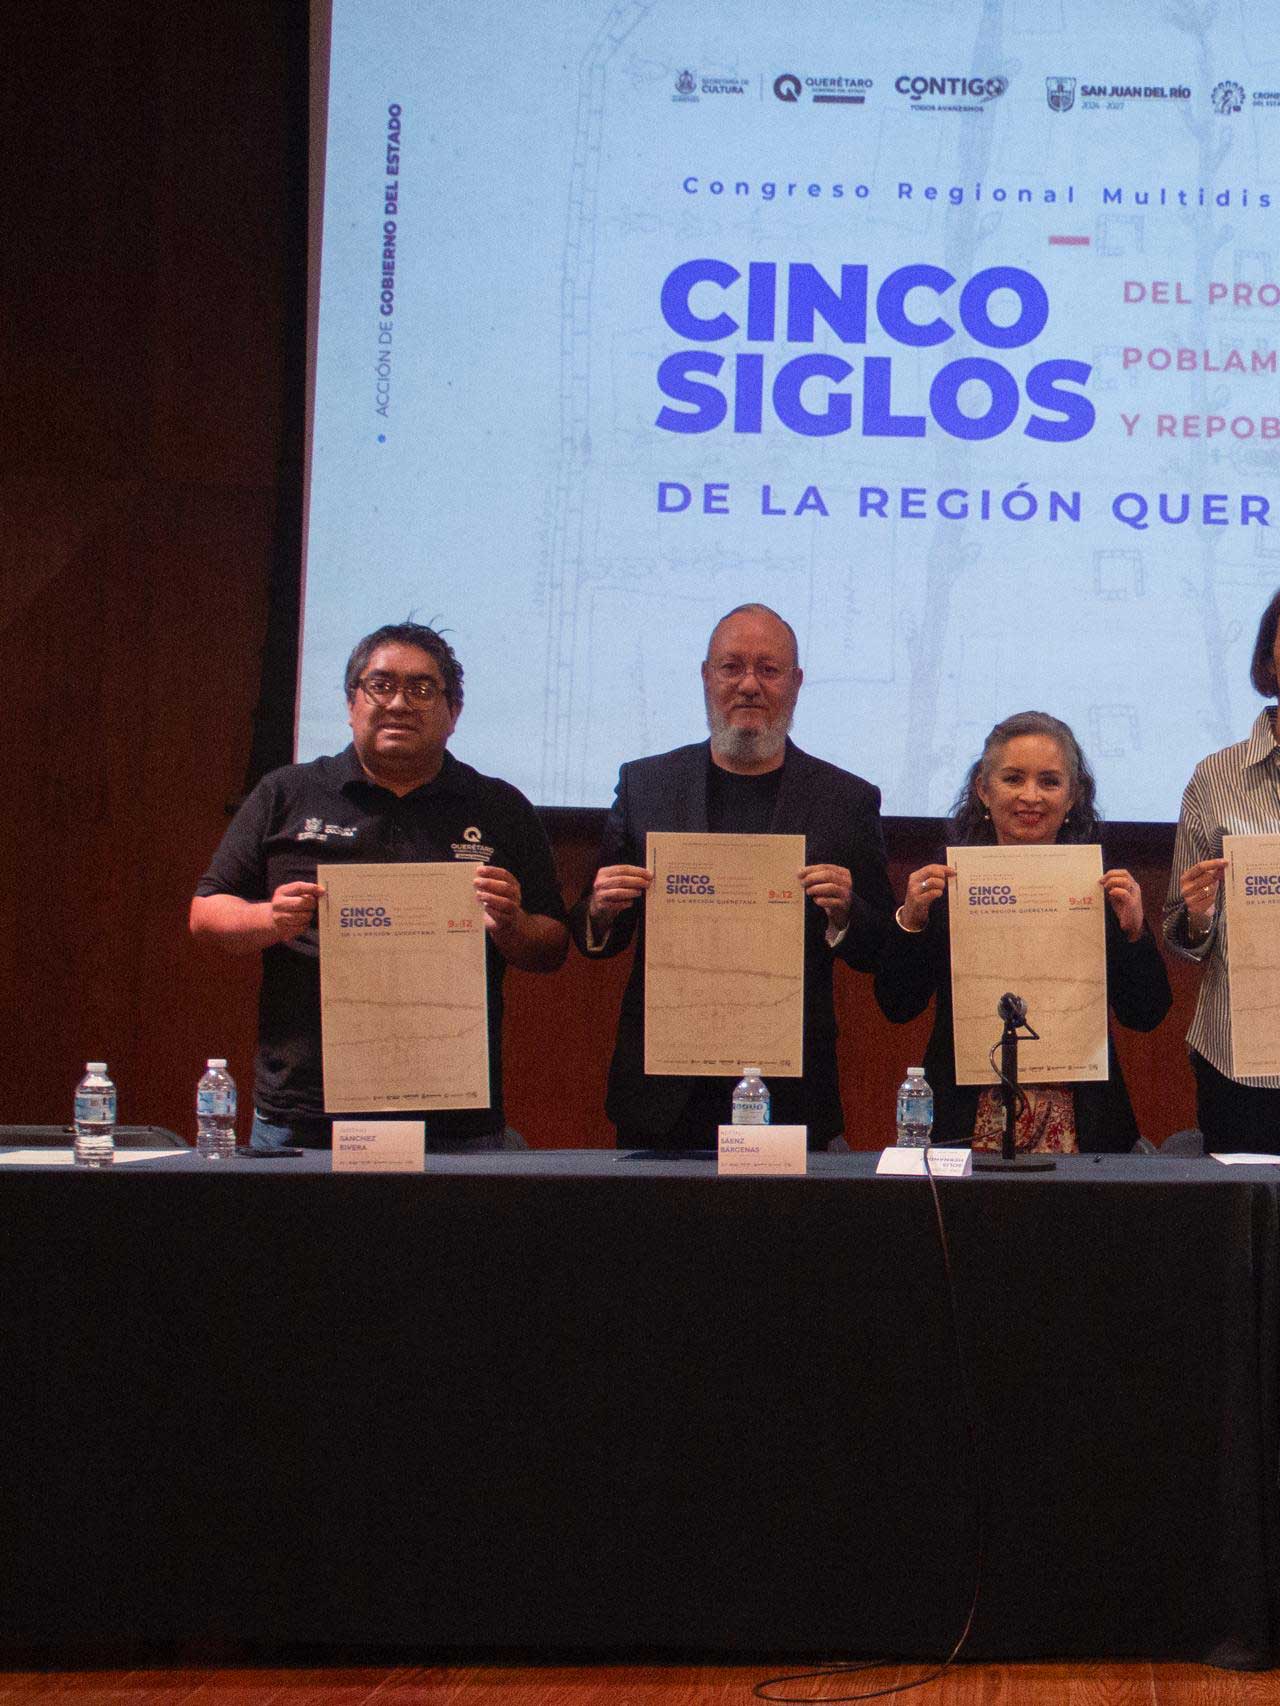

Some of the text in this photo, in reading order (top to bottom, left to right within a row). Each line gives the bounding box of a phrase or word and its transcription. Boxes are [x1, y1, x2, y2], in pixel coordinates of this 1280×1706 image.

[805, 76, 873, 88] QUERÉTARO
[895, 76, 1005, 97] CONTIGO
[701, 85, 744, 94] CULTURA
[1081, 85, 1191, 99] SAN JUAN DEL RÍO
[682, 177, 870, 201] Congreso
[897, 182, 1074, 206] Regional
[375, 103, 402, 418] ACCIÓN DE GOBIERNO DEL ESTADO
[1124, 281, 1191, 305] DEL
[660, 258, 1049, 349] CINCO
[655, 351, 1096, 443] SIGLOS
[1121, 414, 1140, 437] Y
[657, 482, 730, 515] DE
[761, 484, 829, 517] LA
[859, 482, 1081, 522] REGIÓN
[666, 875, 710, 884] CINCO
[666, 885, 715, 894] SIGLOS
[969, 886, 1011, 895] CINCO
[969, 896, 1017, 905] SIGLOS
[341, 907, 385, 917] CINCO
[340, 918, 391, 928] SIGLOS
